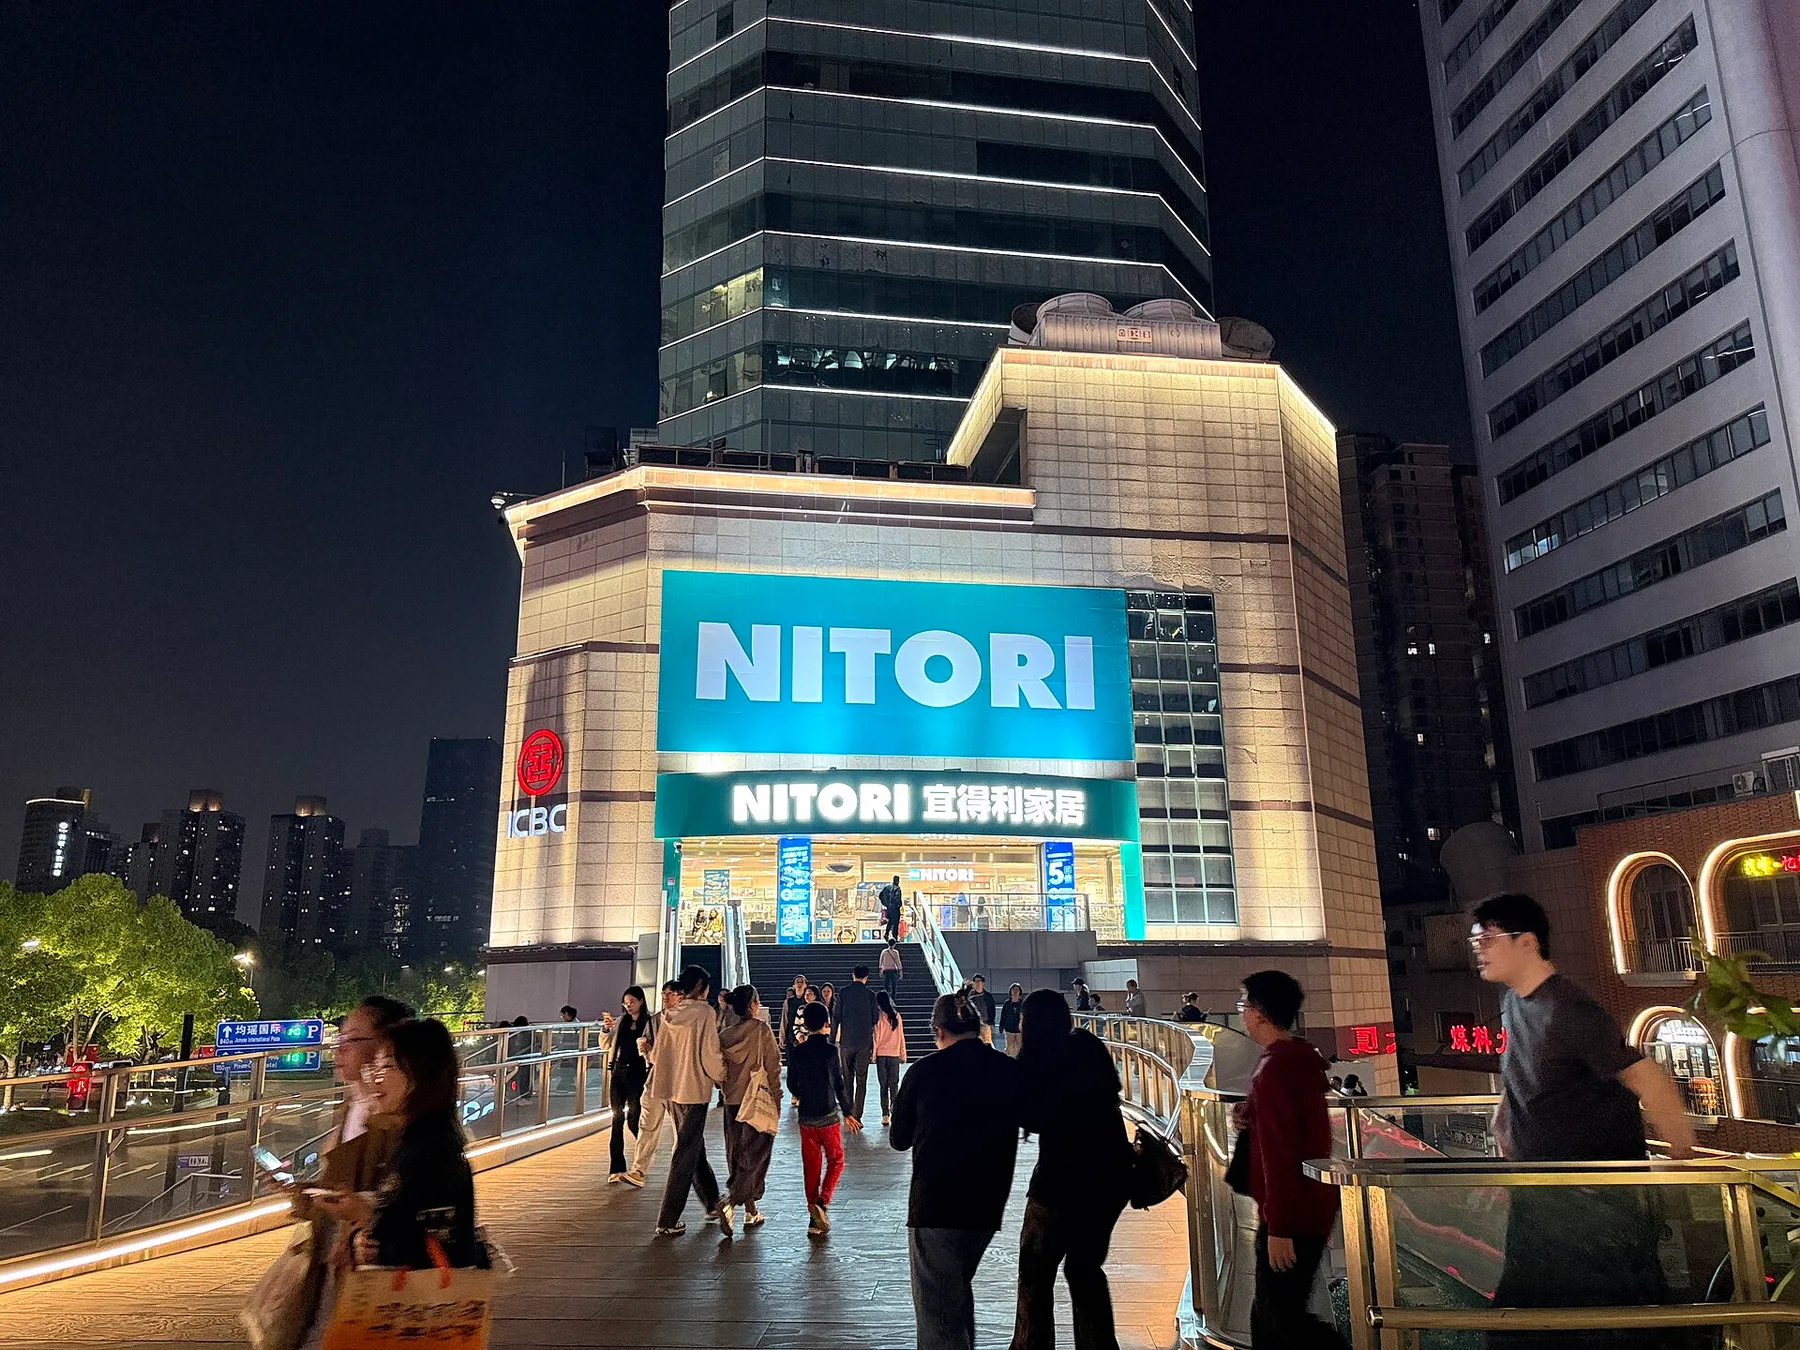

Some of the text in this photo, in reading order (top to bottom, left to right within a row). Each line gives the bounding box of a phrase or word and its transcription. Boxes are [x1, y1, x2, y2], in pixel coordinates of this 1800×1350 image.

[695, 621, 1096, 710] NITORI
[733, 782, 1085, 826] NITORI 宜得利家居
[505, 803, 567, 839] ICBC
[920, 868, 974, 881] NITORI
[236, 1024, 281, 1035] 均瑶国际
[307, 1025, 319, 1038] P
[305, 1051, 317, 1064] P
